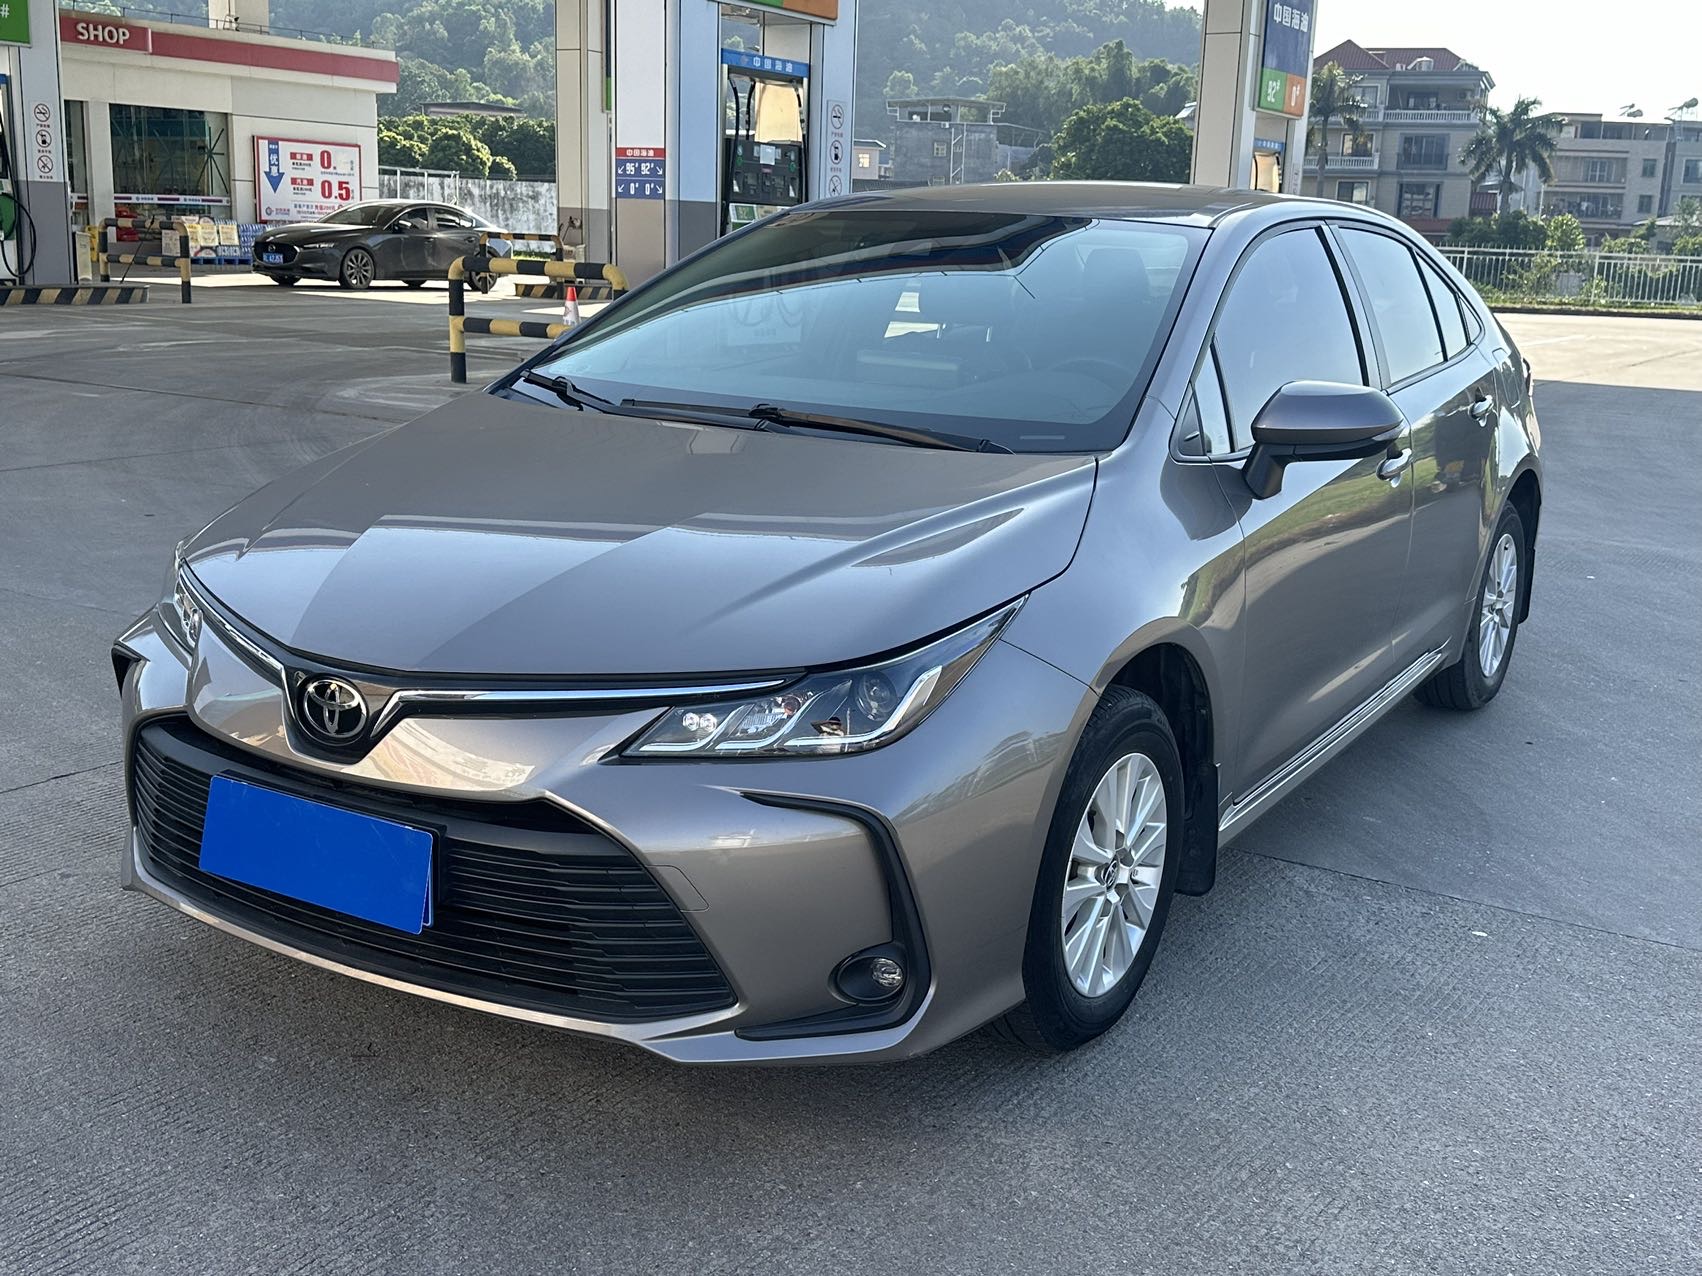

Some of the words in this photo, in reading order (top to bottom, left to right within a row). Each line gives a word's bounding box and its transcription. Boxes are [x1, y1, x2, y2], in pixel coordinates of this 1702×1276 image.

[1273, 2, 1309, 33] 中国海油
[76, 22, 130, 45] SHOP
[320, 179, 351, 202] 0.5
